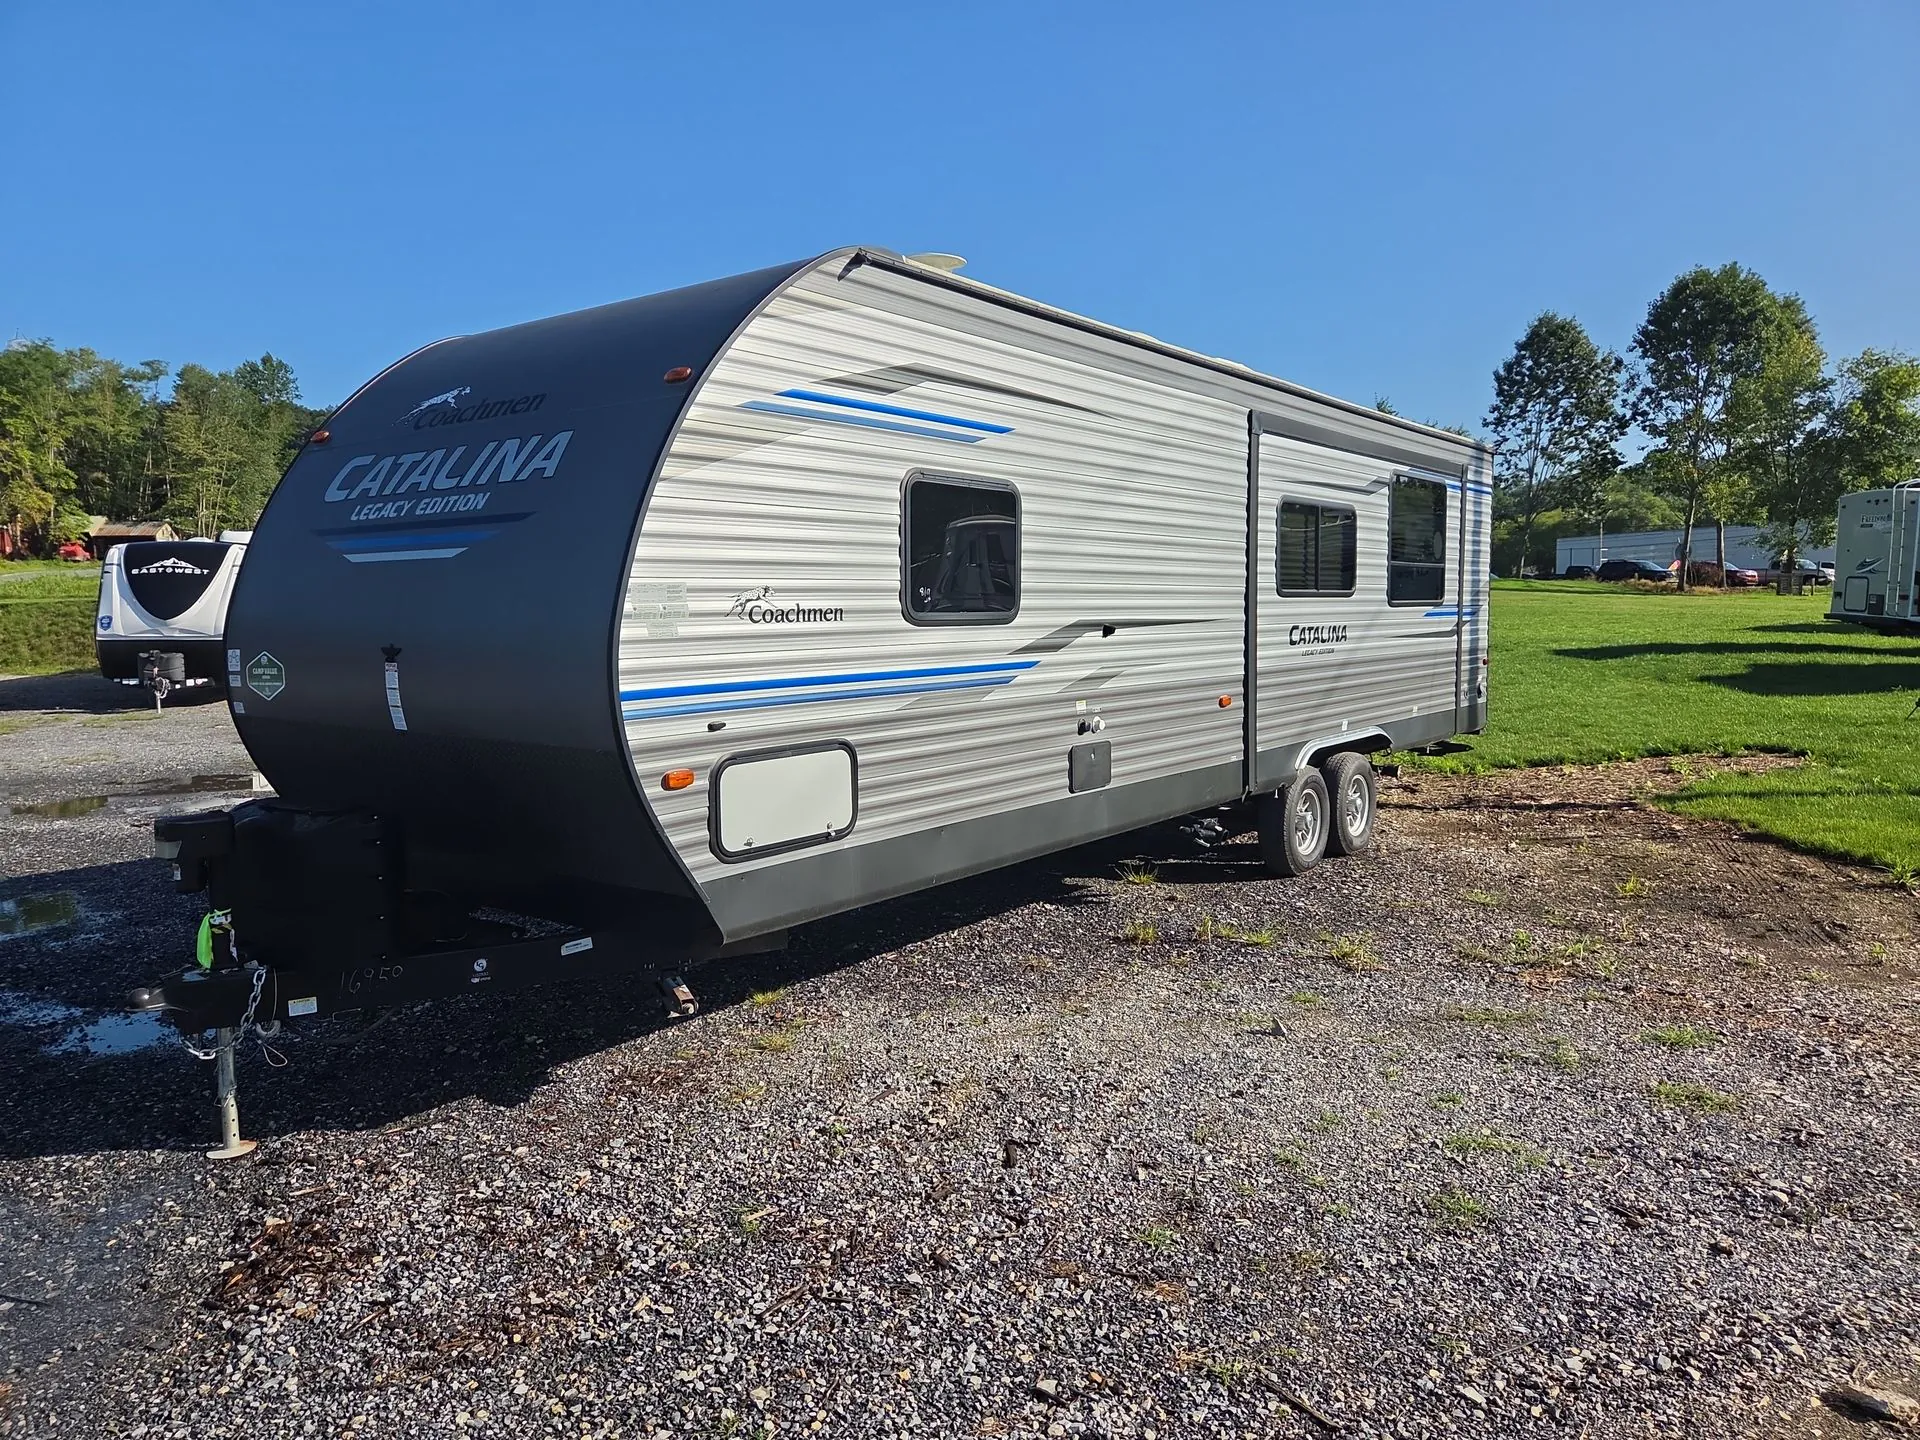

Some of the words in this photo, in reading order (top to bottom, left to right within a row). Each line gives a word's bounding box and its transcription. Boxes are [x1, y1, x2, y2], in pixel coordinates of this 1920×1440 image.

[413, 393, 547, 431] Coachmen
[323, 429, 575, 504] CATALINA
[350, 498, 416, 521] LEGACY
[415, 491, 492, 516] EDITION
[131, 567, 165, 575] EAST
[174, 567, 210, 575] WEST
[748, 603, 844, 624] Coachmen
[1289, 625, 1347, 646] CATALINA
